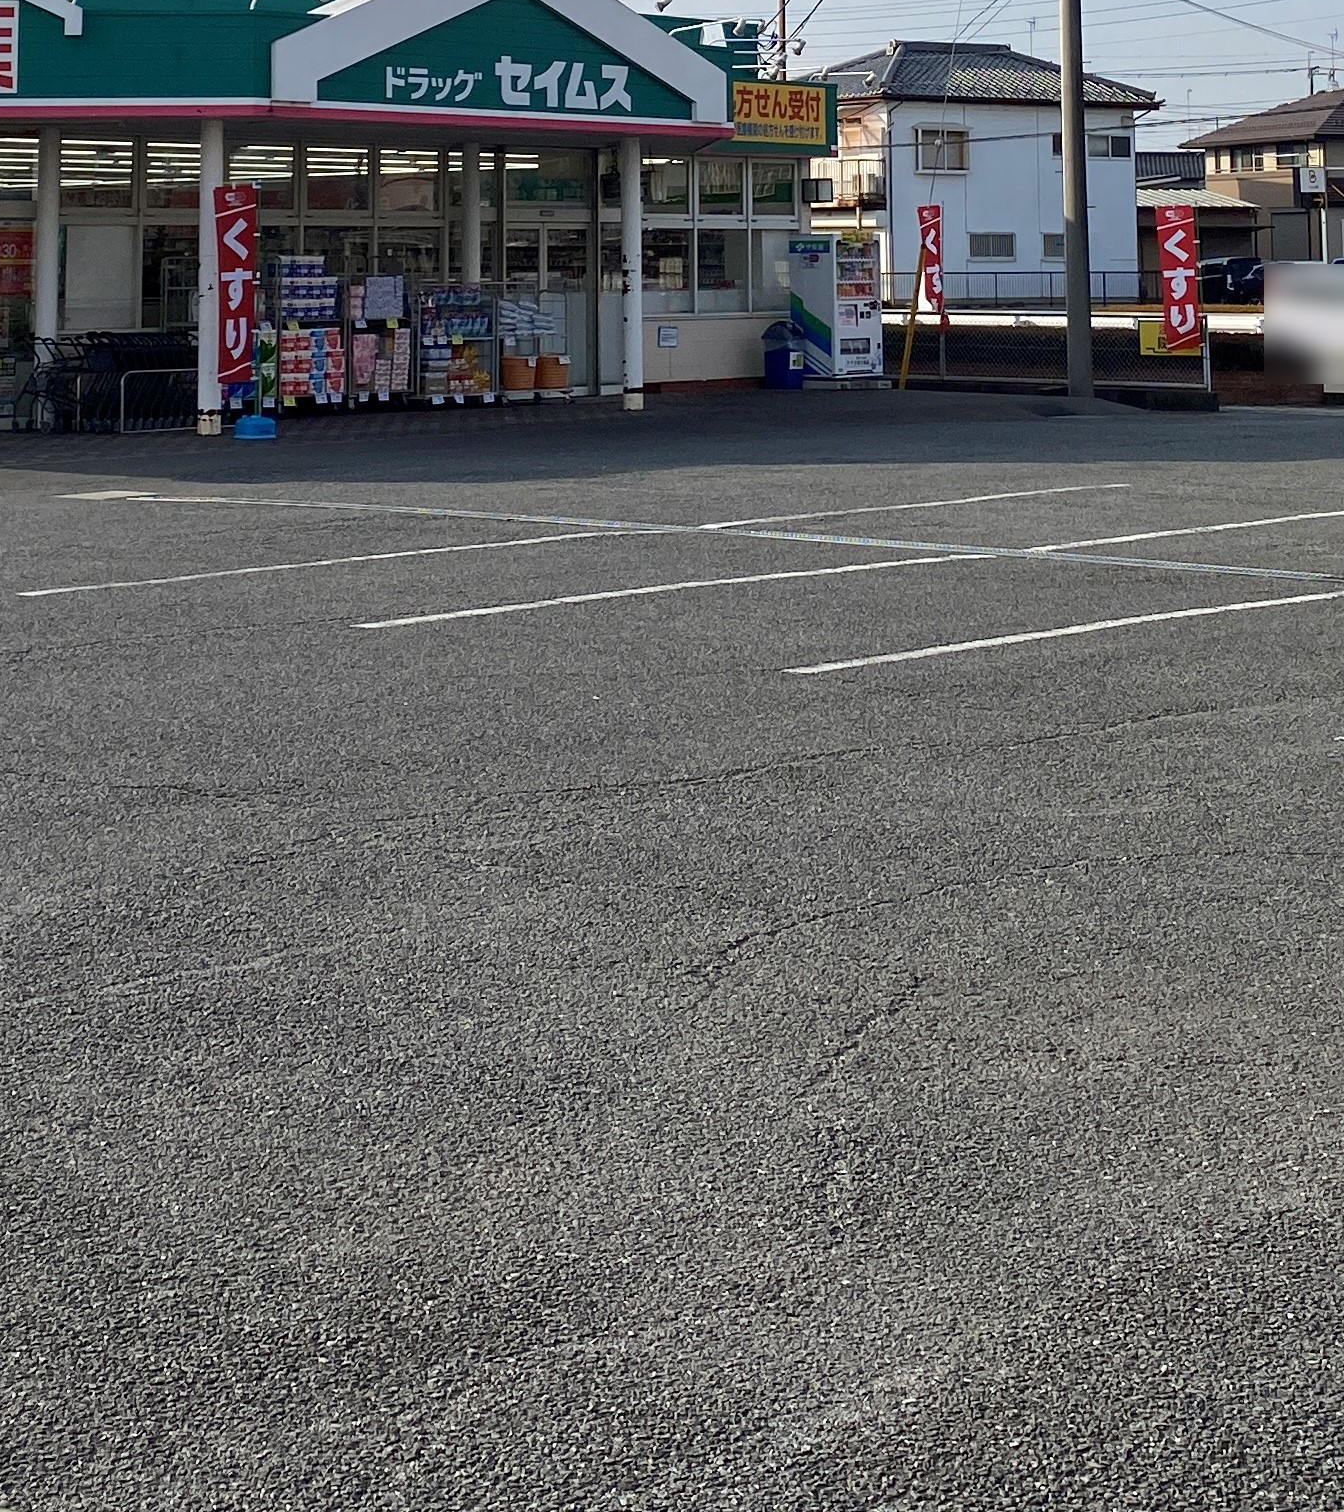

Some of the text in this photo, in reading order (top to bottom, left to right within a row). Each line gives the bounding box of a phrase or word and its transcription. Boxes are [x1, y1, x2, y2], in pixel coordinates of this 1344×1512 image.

[385, 55, 632, 112] ドラッグ セイムス
[734, 85, 821, 122] 方せん受付
[221, 217, 254, 361] くすり
[1163, 228, 1196, 335] くすり
